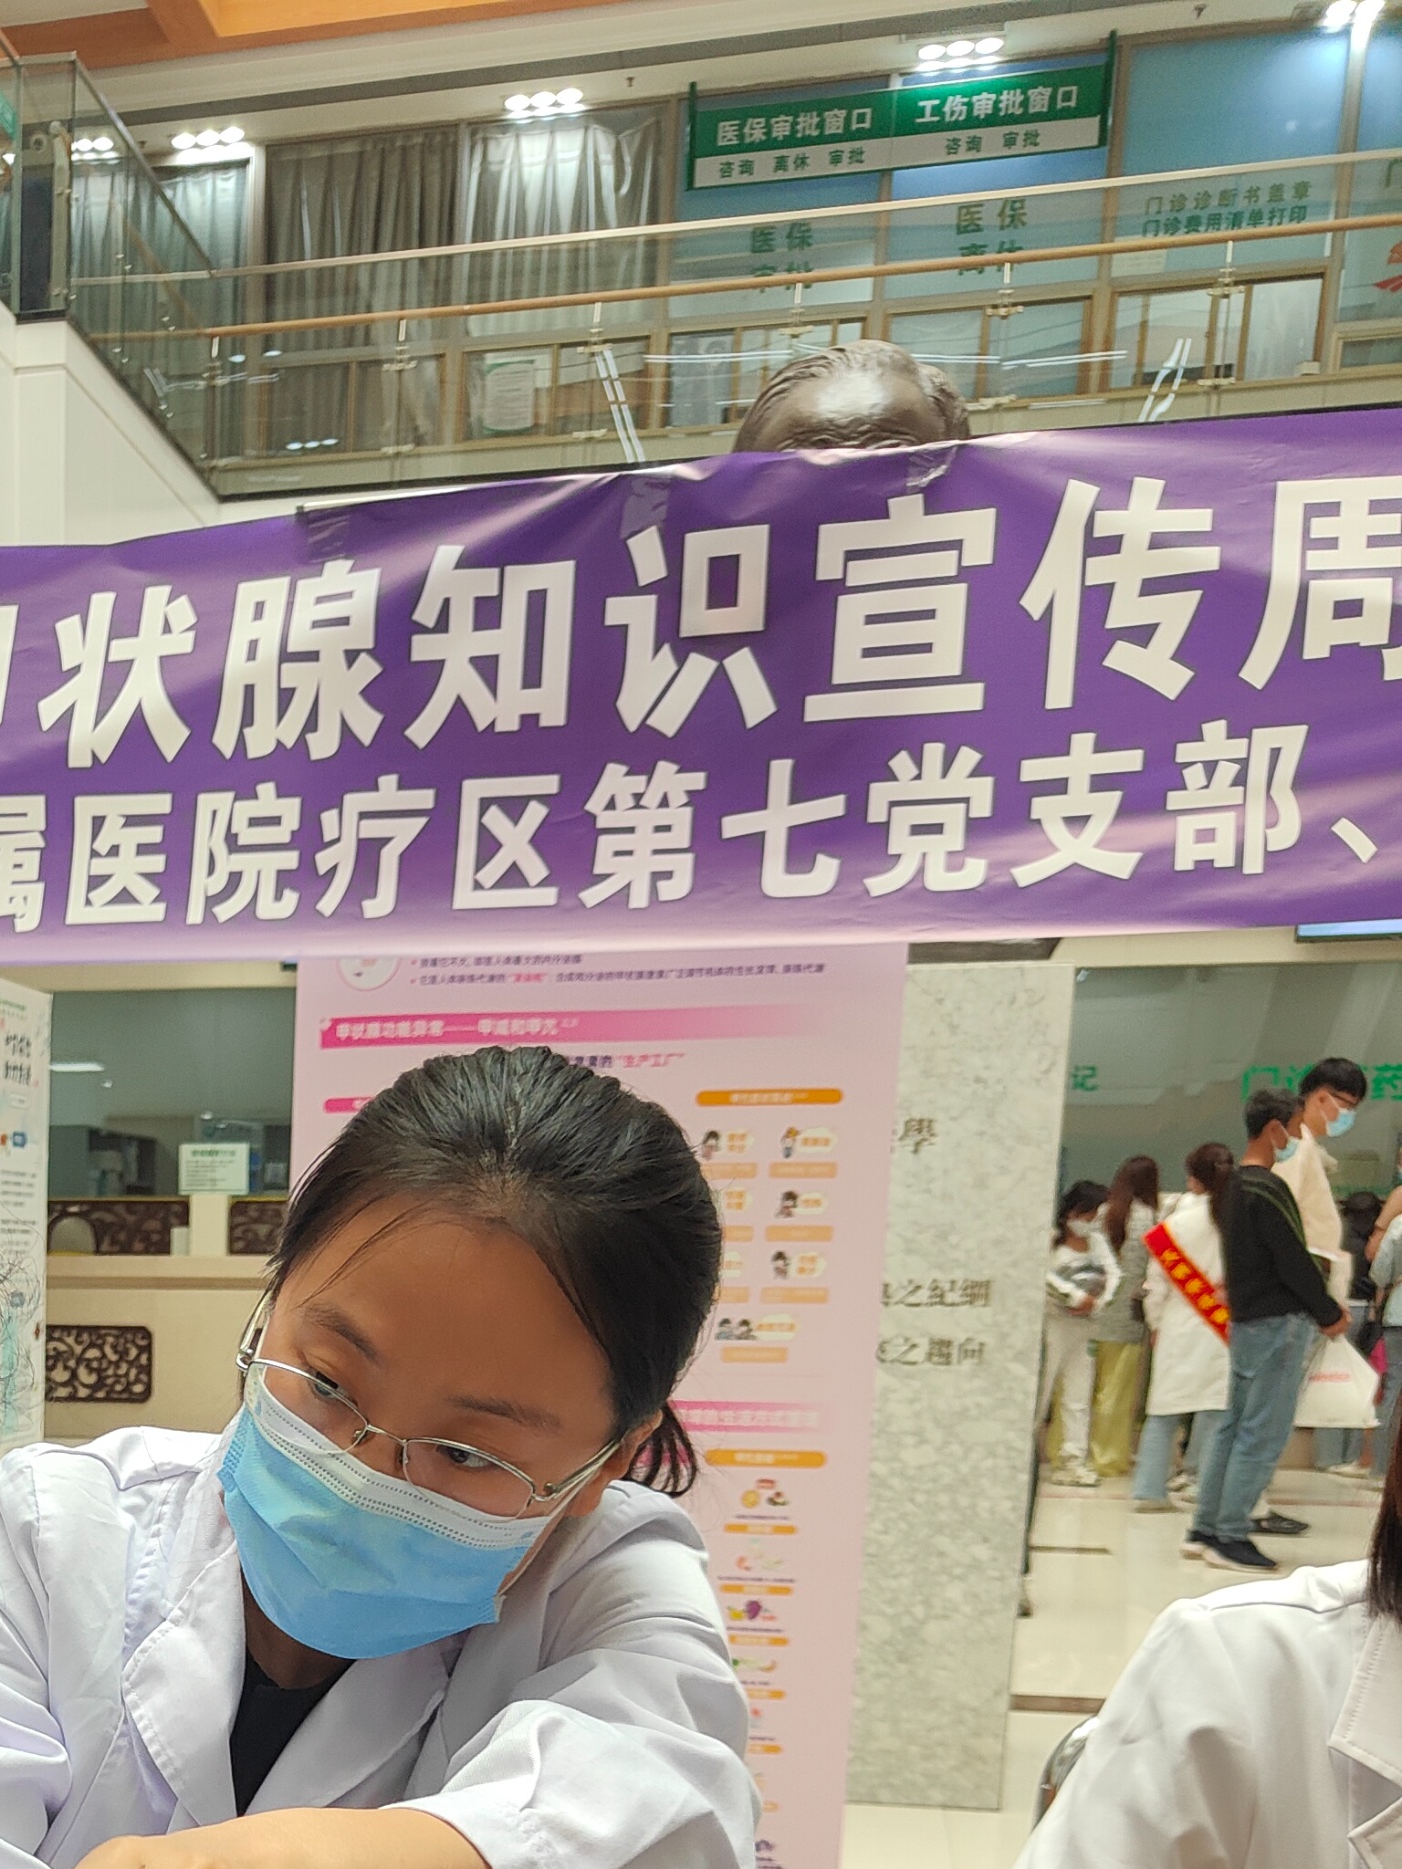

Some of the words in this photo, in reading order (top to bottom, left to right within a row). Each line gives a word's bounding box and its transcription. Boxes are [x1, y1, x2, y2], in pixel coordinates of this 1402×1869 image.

[717, 107, 873, 146] 医保审批窗口
[914, 85, 1079, 122] 工伤审批窗口
[719, 159, 755, 179] 咨询
[828, 146, 866, 167] 审批
[945, 135, 982, 156] 咨询
[1002, 128, 1040, 149] 审批
[750, 221, 814, 254] 医保
[956, 198, 1028, 236] 医保
[1141, 204, 1309, 238] 门诊费用清单打印
